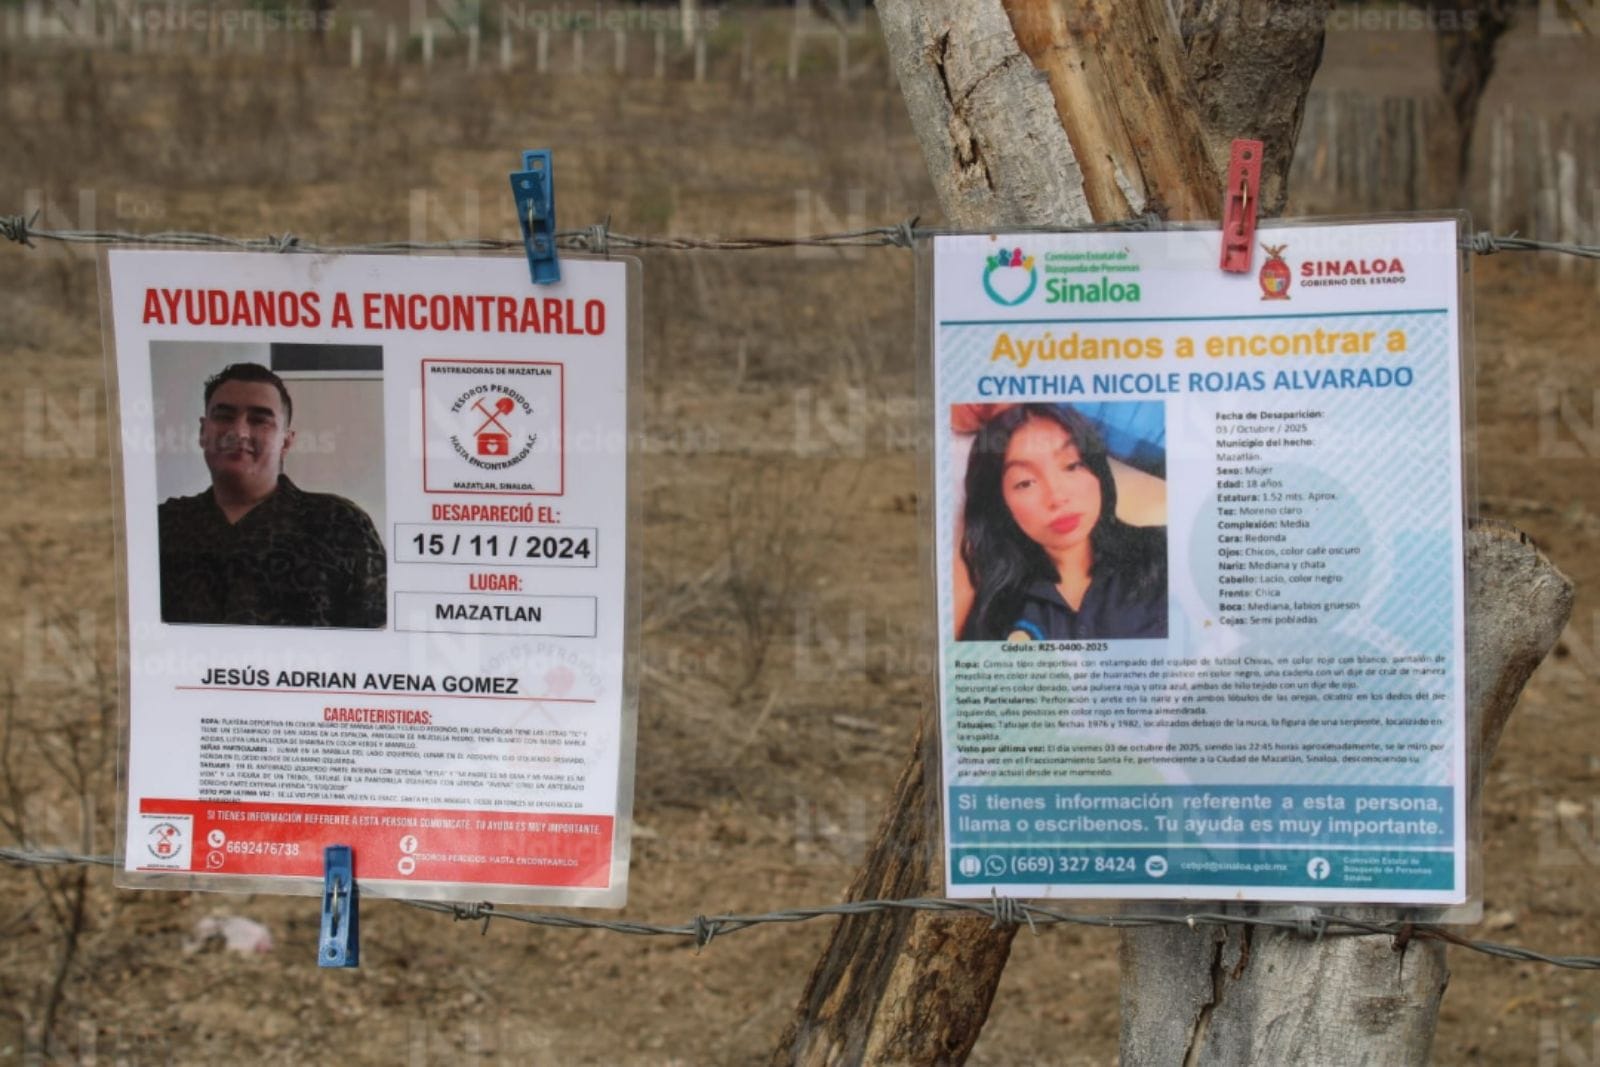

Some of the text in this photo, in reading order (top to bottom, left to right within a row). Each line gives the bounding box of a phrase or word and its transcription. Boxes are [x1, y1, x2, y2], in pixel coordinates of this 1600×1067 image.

[1300, 257, 1405, 277] SINALOA
[1300, 276, 1406, 287] GOBIERNO DEL ESTADO
[1045, 276, 1141, 303] Sinaloa
[143, 288, 605, 336] AYUDANOS A ENCONTRARLO
[990, 329, 1407, 368] Ayúdanos a encontrar a
[496, 367, 506, 375] DE
[508, 367, 552, 376] MAZATLAN
[977, 366, 1414, 396] CYNTHIA NICOLE ROJAS ALVARADO
[451, 384, 534, 415] TESOROS PERDIDOS
[1215, 411, 1243, 420] Fecha
[1245, 411, 1257, 420] de
[1215, 426, 1227, 434] 03
[1236, 424, 1274, 434] Octubre
[1284, 423, 1308, 433] 2025
[450, 435, 469, 460] HASTA
[1216, 438, 1264, 449] Municipio
[1266, 438, 1281, 447] del
[1216, 466, 1273, 477] Sexo: Mujer
[1217, 479, 1283, 488] Edad: 18 años
[1217, 493, 1260, 502] Estatura:
[1263, 492, 1282, 501] 1.52
[432, 503, 560, 524] DESAPARECIÓ EL:
[1217, 505, 1302, 516] Tez: Moreno claro
[1218, 519, 1310, 530] Complexión: Media
[1218, 533, 1286, 543] Cara: Redonda
[413, 533, 590, 559] 15 / 11 / 2024
[1218, 548, 1243, 558] Ojos:
[1245, 547, 1279, 557] Chicos,
[1280, 546, 1304, 555] color
[1328, 547, 1361, 555] oscuro
[1218, 561, 1246, 570] Nariz:
[1248, 560, 1290, 570] Mediana
[1300, 560, 1325, 569] chata
[469, 573, 523, 591] LUGAR:
[1219, 575, 1258, 584] Cabello:
[1288, 574, 1312, 583] color
[1315, 574, 1343, 584] negro
[1255, 587, 1280, 597] Chica
[435, 603, 541, 622] MAZATLAN
[1219, 601, 1361, 612] Boca: Mediana, labios gruesos
[1250, 615, 1273, 624] Semi
[1275, 615, 1317, 625] pobladas
[201, 665, 518, 694] JESÚS ADRIAN AVENA GOMEZ
[323, 707, 432, 726] CARACTERISTICAS:
[958, 793, 1444, 814] Si tienes información referente a esta persona,
[218, 810, 246, 821] TIENES
[247, 811, 302, 824] INFORMACIÓN
[304, 813, 350, 825] REFERENTE
[359, 815, 378, 826] ESTA
[381, 815, 417, 827] PERSONA
[487, 820, 514, 831] AYUDA
[515, 821, 526, 832] ES
[527, 821, 545, 833] MUY
[958, 816, 1011, 832] llama
[1016, 819, 1029, 832] o
[1155, 815, 1179, 832] Tu
[1184, 816, 1244, 835] ayuda
[1250, 818, 1273, 832] es
[1279, 818, 1322, 836] muy
[1328, 816, 1445, 836] importante.
[226, 841, 299, 856] 6692476738
[1011, 855, 1136, 875] (669) 327 8424
